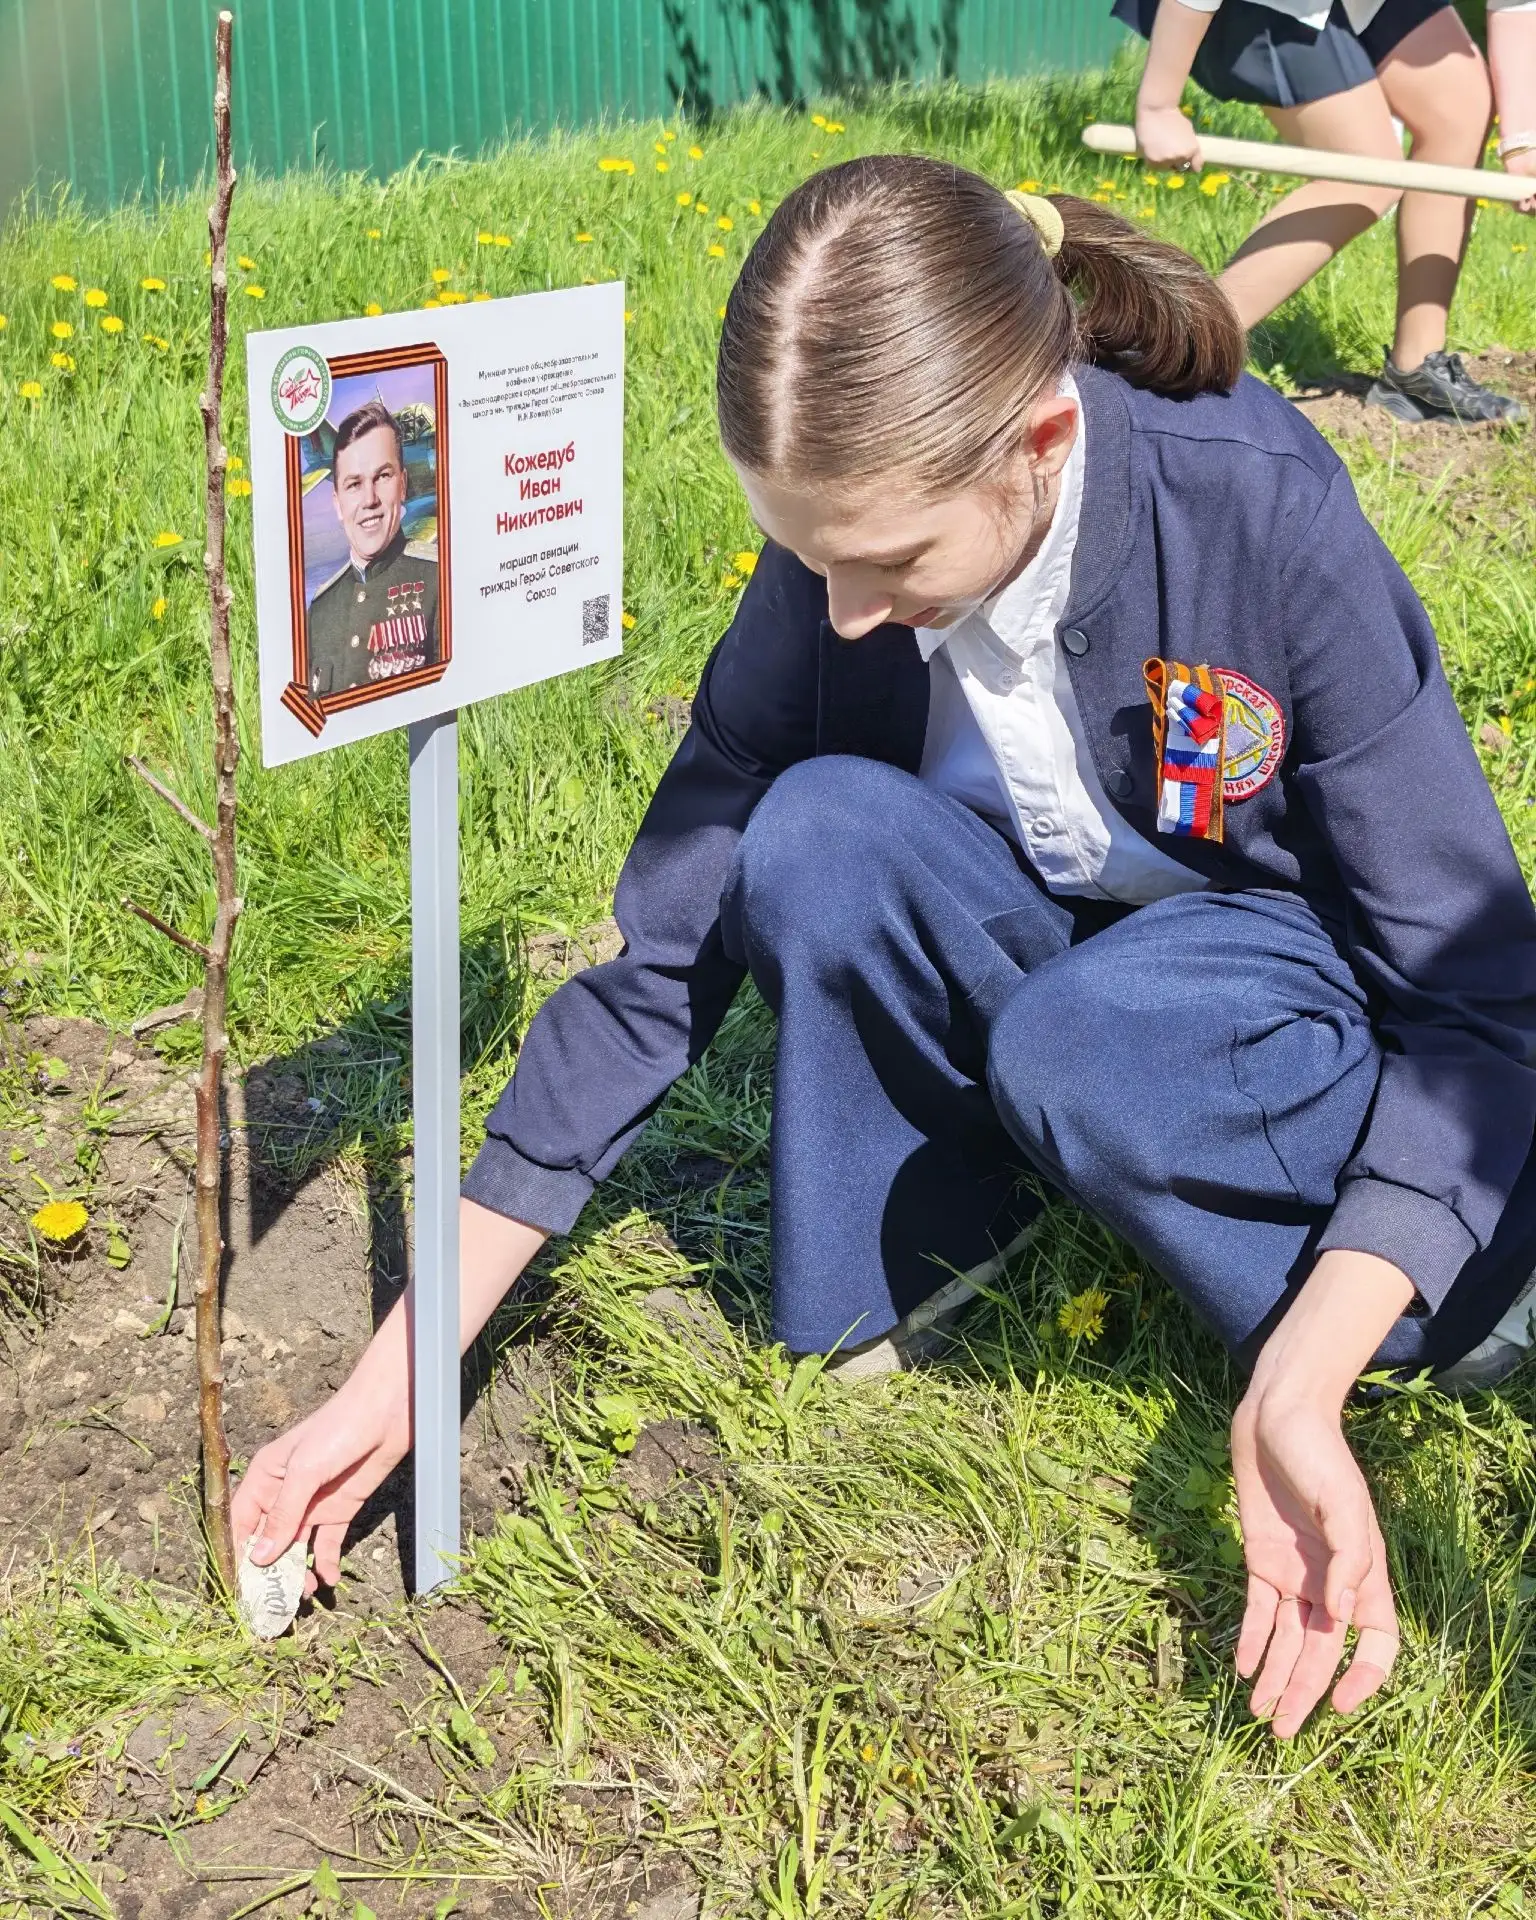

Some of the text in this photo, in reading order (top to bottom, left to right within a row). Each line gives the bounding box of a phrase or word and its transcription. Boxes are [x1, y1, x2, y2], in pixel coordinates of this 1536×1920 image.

[504, 441, 575, 476] Кожедуб
[519, 477, 561, 500] Иван
[496, 499, 583, 535] Никитович
[480, 555, 600, 598] трижды Герой Советского
[499, 553, 537, 572] маршал
[526, 585, 557, 603] Союза
[1224, 678, 1267, 711] рская
